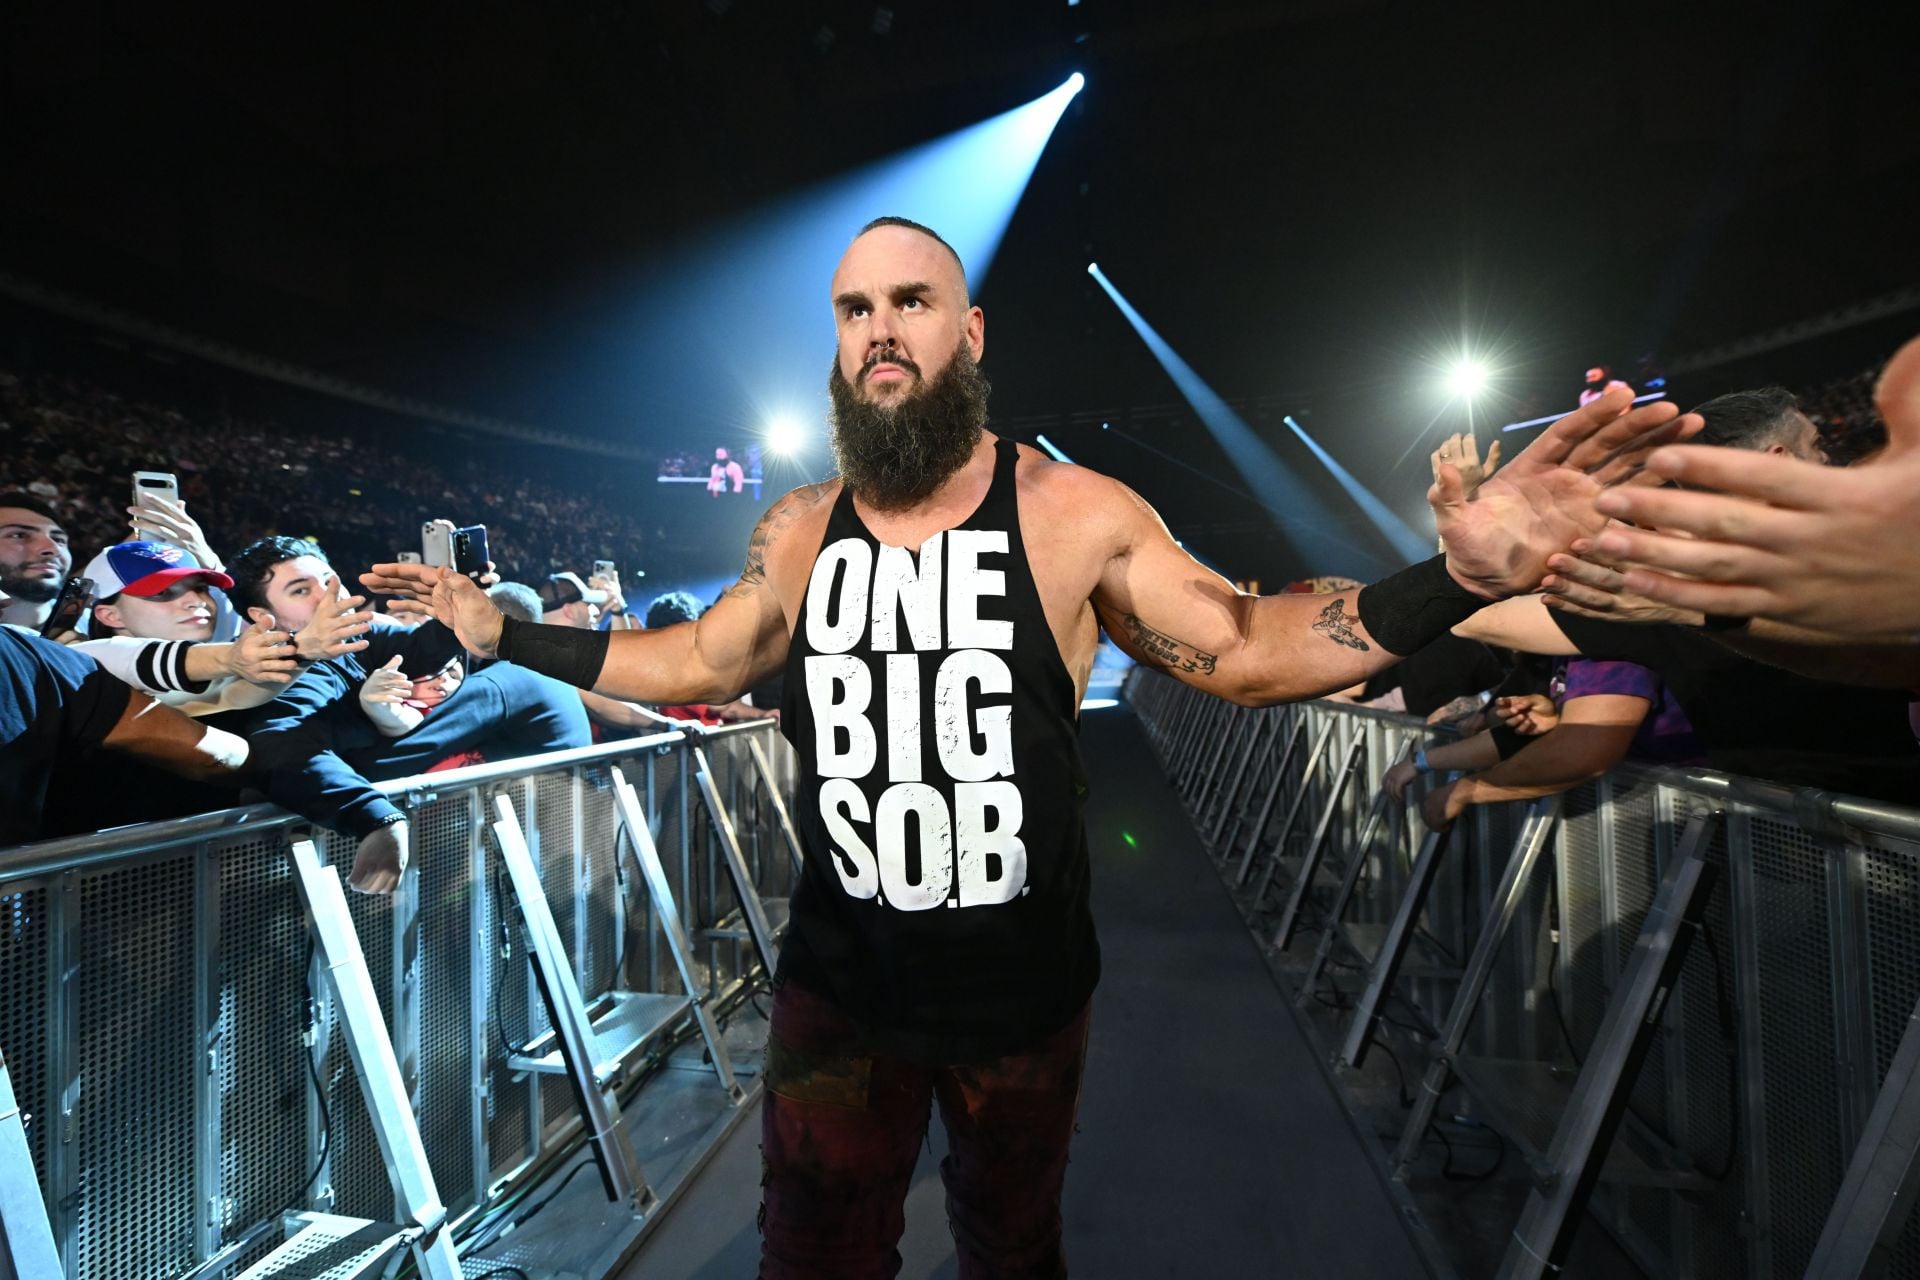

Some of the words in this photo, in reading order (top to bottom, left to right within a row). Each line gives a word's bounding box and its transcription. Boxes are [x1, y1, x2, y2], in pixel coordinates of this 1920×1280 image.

[806, 530, 1014, 654] ONE
[804, 649, 1015, 782] BIG
[819, 778, 1030, 911] S.O.B.
